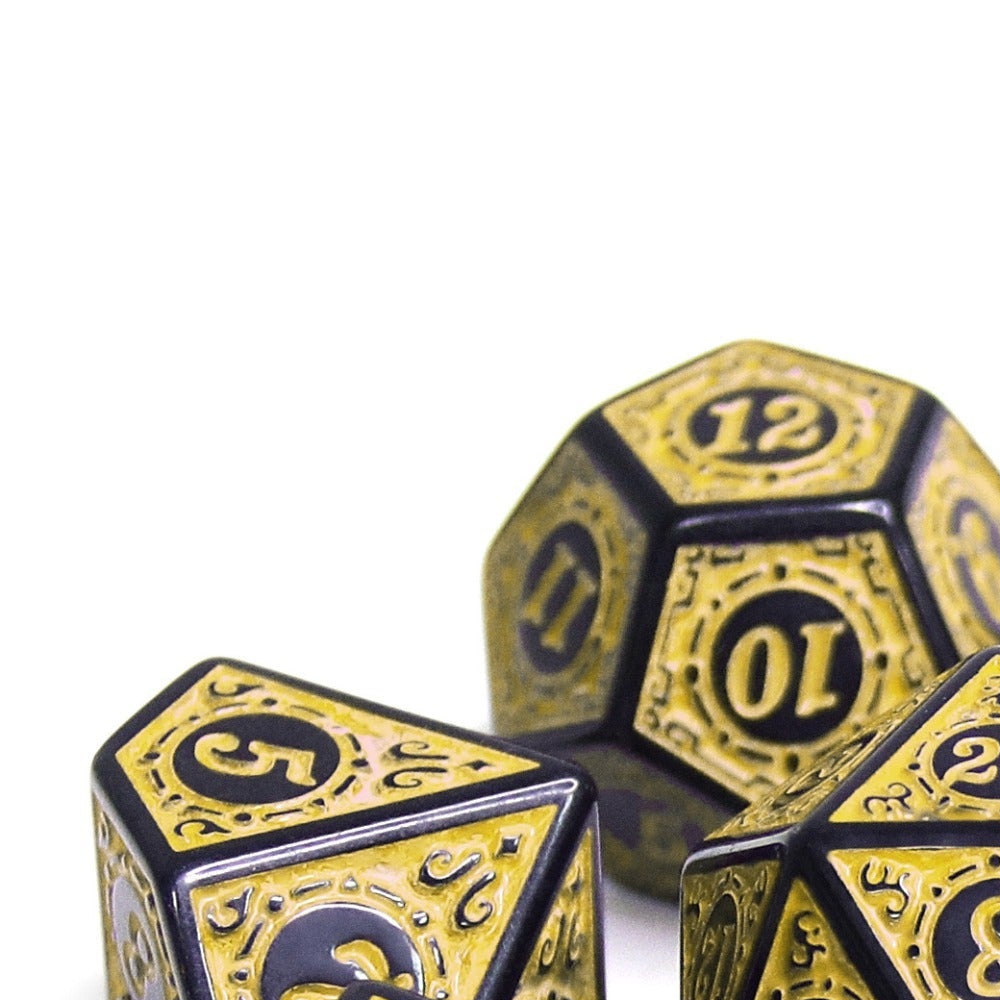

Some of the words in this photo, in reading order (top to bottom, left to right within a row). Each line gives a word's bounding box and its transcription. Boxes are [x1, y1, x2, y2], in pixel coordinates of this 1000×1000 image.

[707, 394, 823, 457] 12
[522, 541, 597, 652] 11
[725, 620, 848, 722] 10
[193, 732, 317, 785] 5
